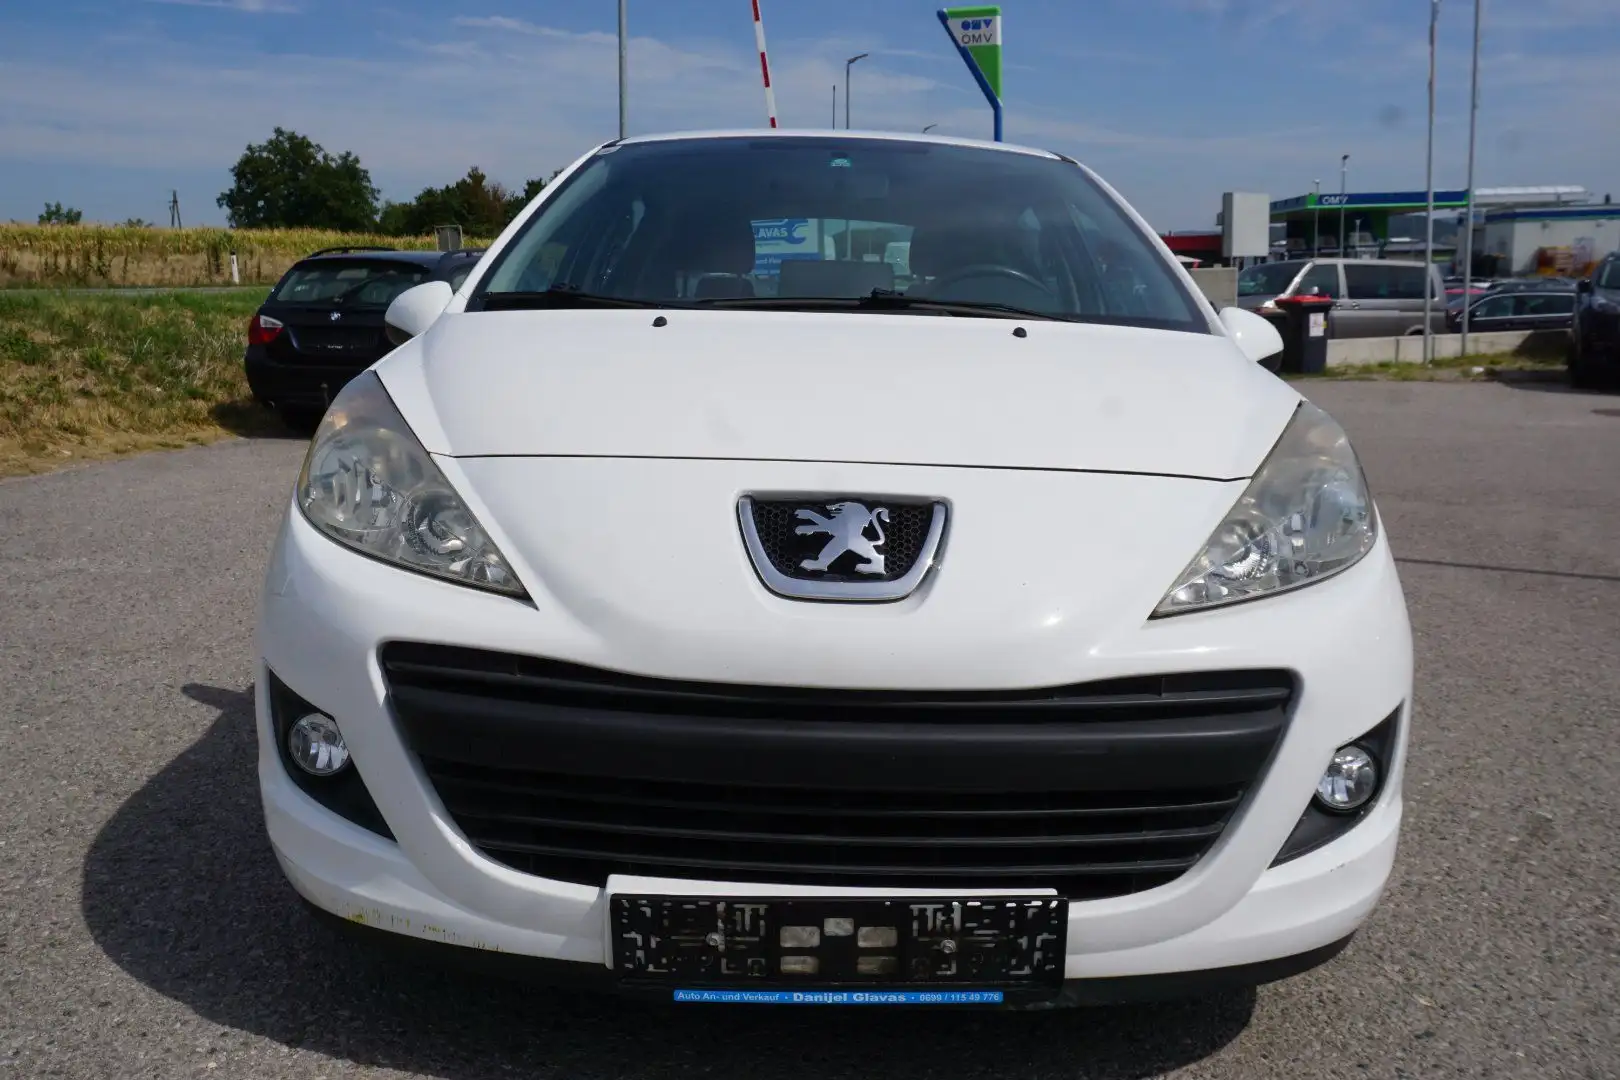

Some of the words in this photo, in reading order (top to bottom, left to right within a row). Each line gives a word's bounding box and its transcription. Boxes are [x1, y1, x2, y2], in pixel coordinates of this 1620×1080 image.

[961, 33, 993, 45] OMV
[677, 992, 701, 1000] Auto
[702, 992, 720, 1000] An-
[722, 992, 740, 1001] und
[742, 992, 780, 1002] Verkauf
[793, 992, 847, 1003] Danijel
[853, 992, 906, 1002] Glavas
[919, 993, 942, 1002] 0699
[951, 993, 966, 1002] 115
[968, 993, 980, 1002] 49
[983, 993, 999, 1001] 776
